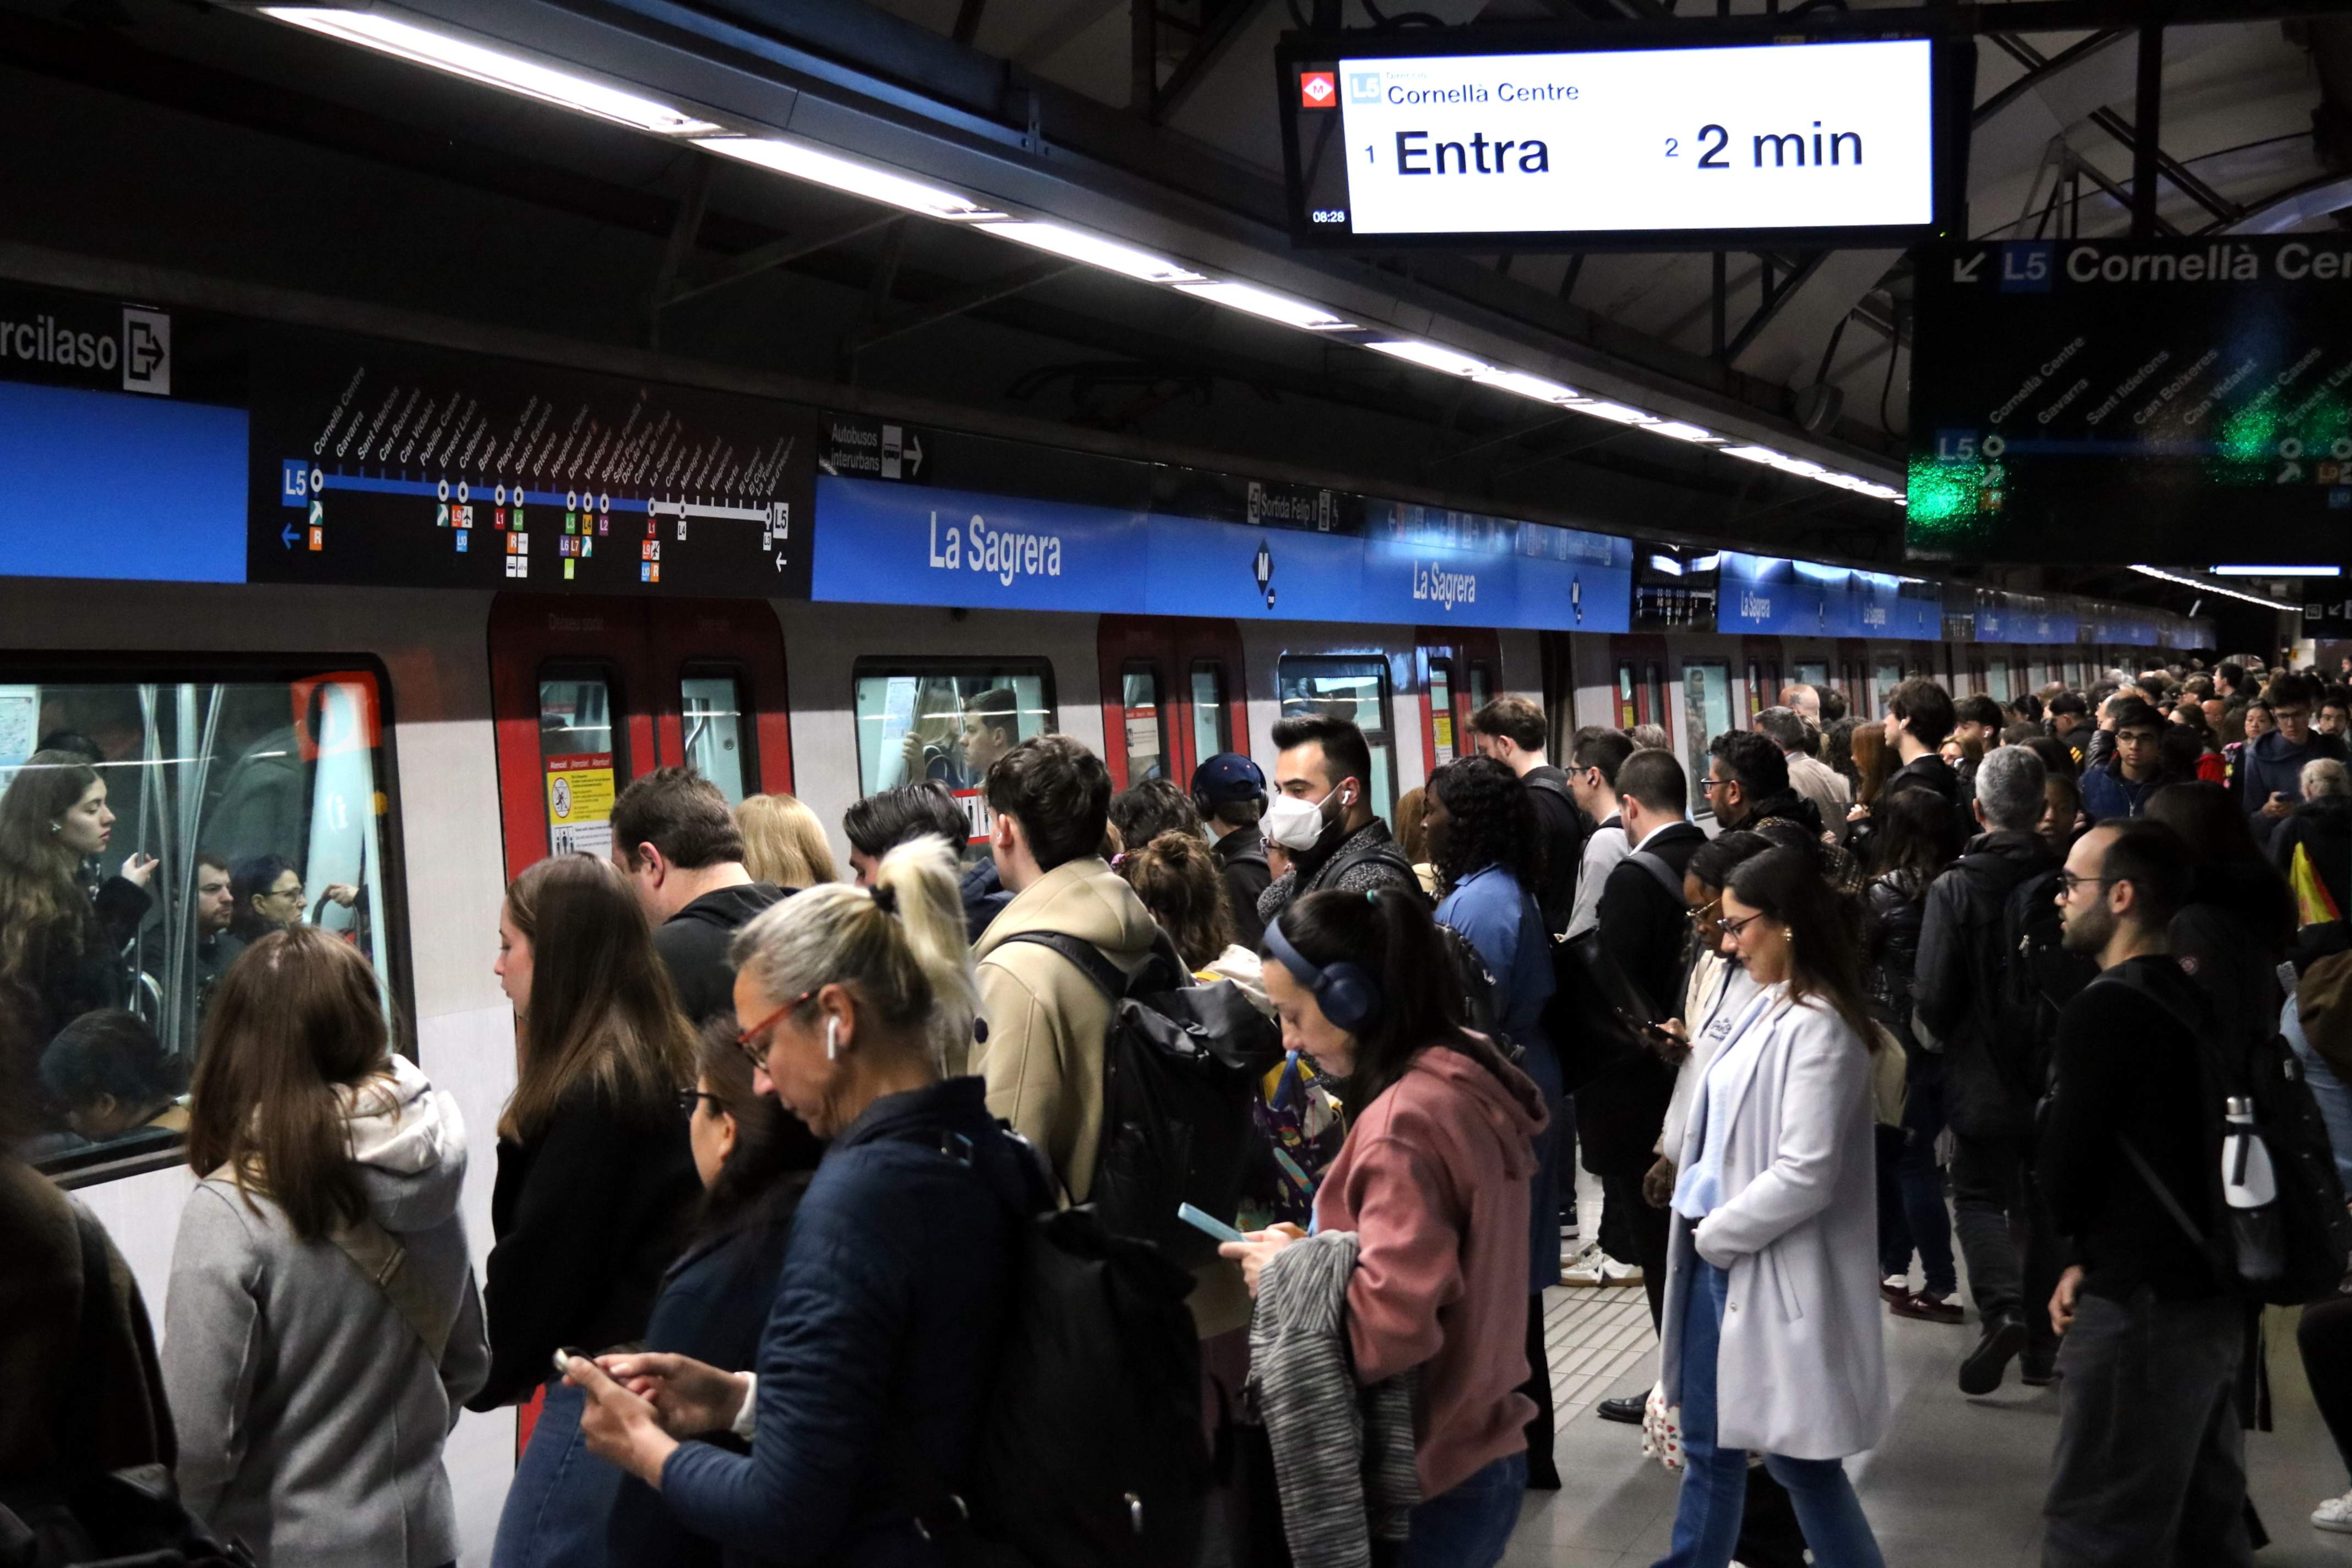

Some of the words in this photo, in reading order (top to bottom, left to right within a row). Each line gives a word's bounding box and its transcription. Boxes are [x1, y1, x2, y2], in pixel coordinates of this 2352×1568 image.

[1352, 78, 1379, 98] L5
[1387, 82, 1489, 105] Cornellà
[1497, 82, 1579, 102] Centre
[1364, 144, 1374, 164] 1
[1395, 130, 1550, 175] Entra
[1664, 138, 1679, 157] 2
[1697, 123, 1730, 169] 2
[1753, 120, 1863, 168] min
[1313, 211, 1344, 223] 08:28
[2003, 252, 2048, 281] L5
[2066, 243, 2259, 283] Cornellà
[2039, 336, 2085, 378] Centre
[2277, 346, 2322, 386] Cases
[2037, 376, 2090, 425] Gavarra
[2086, 394, 2121, 426] Sant
[2116, 349, 2170, 399] Ildefons
[2133, 398, 2163, 426] Can
[2159, 348, 2220, 402] Boixeres
[2182, 398, 2213, 426] Can
[2209, 357, 2260, 401] Vidalet
[336, 411, 364, 458] Gavarra
[357, 429, 376, 461] Sant
[372, 385, 400, 434] Ildefons
[379, 436, 395, 462] Can
[391, 387, 421, 438] Boixeres
[400, 438, 416, 464] Can
[411, 398, 436, 439] Vidalet
[420, 427, 443, 467] Pubilla
[440, 391, 461, 427] Cases
[439, 428, 462, 469] Ernest
[458, 399, 478, 432] Lluch
[497, 440, 515, 474] Plaça
[513, 426, 522, 442] de
[520, 394, 537, 427] Sants
[831, 422, 878, 447] Autobusos
[459, 417, 488, 469] Collblanc
[478, 435, 497, 472] Badal
[533, 432, 557, 477] Entença
[550, 431, 574, 478] Hospital
[568, 429, 592, 480] Diagonal
[584, 427, 612, 480] Verdaguer
[1937, 437, 1975, 461] L5
[515, 443, 533, 475] Sants
[601, 439, 624, 483] Sagrada
[613, 456, 627, 484] Sant
[621, 461, 634, 484] Dos
[634, 453, 650, 484] Camp
[830, 447, 880, 472] interurbans
[2319, 466, 2338, 480] L9
[285, 469, 306, 496] L5
[650, 471, 658, 488] La
[724, 464, 739, 494] Horta
[452, 509, 461, 522] L9
[496, 512, 504, 525] L1
[514, 513, 523, 526] L3
[567, 518, 575, 529] L3
[775, 510, 787, 530] L5
[1261, 493, 1290, 519] Sortida
[1291, 497, 1311, 525] Felip
[313, 530, 322, 544] R
[584, 519, 591, 530] L4
[600, 520, 608, 531] L2
[648, 522, 656, 534] L1
[678, 525, 686, 536] L4
[511, 535, 517, 548] R
[560, 540, 569, 551] L6
[571, 540, 579, 552] L7
[930, 510, 960, 569] La
[968, 514, 1061, 586] Sagrera
[1258, 552, 1268, 581] M
[1413, 560, 1427, 600] La
[1430, 561, 1476, 611] Sagrera
[1741, 590, 1748, 617] La
